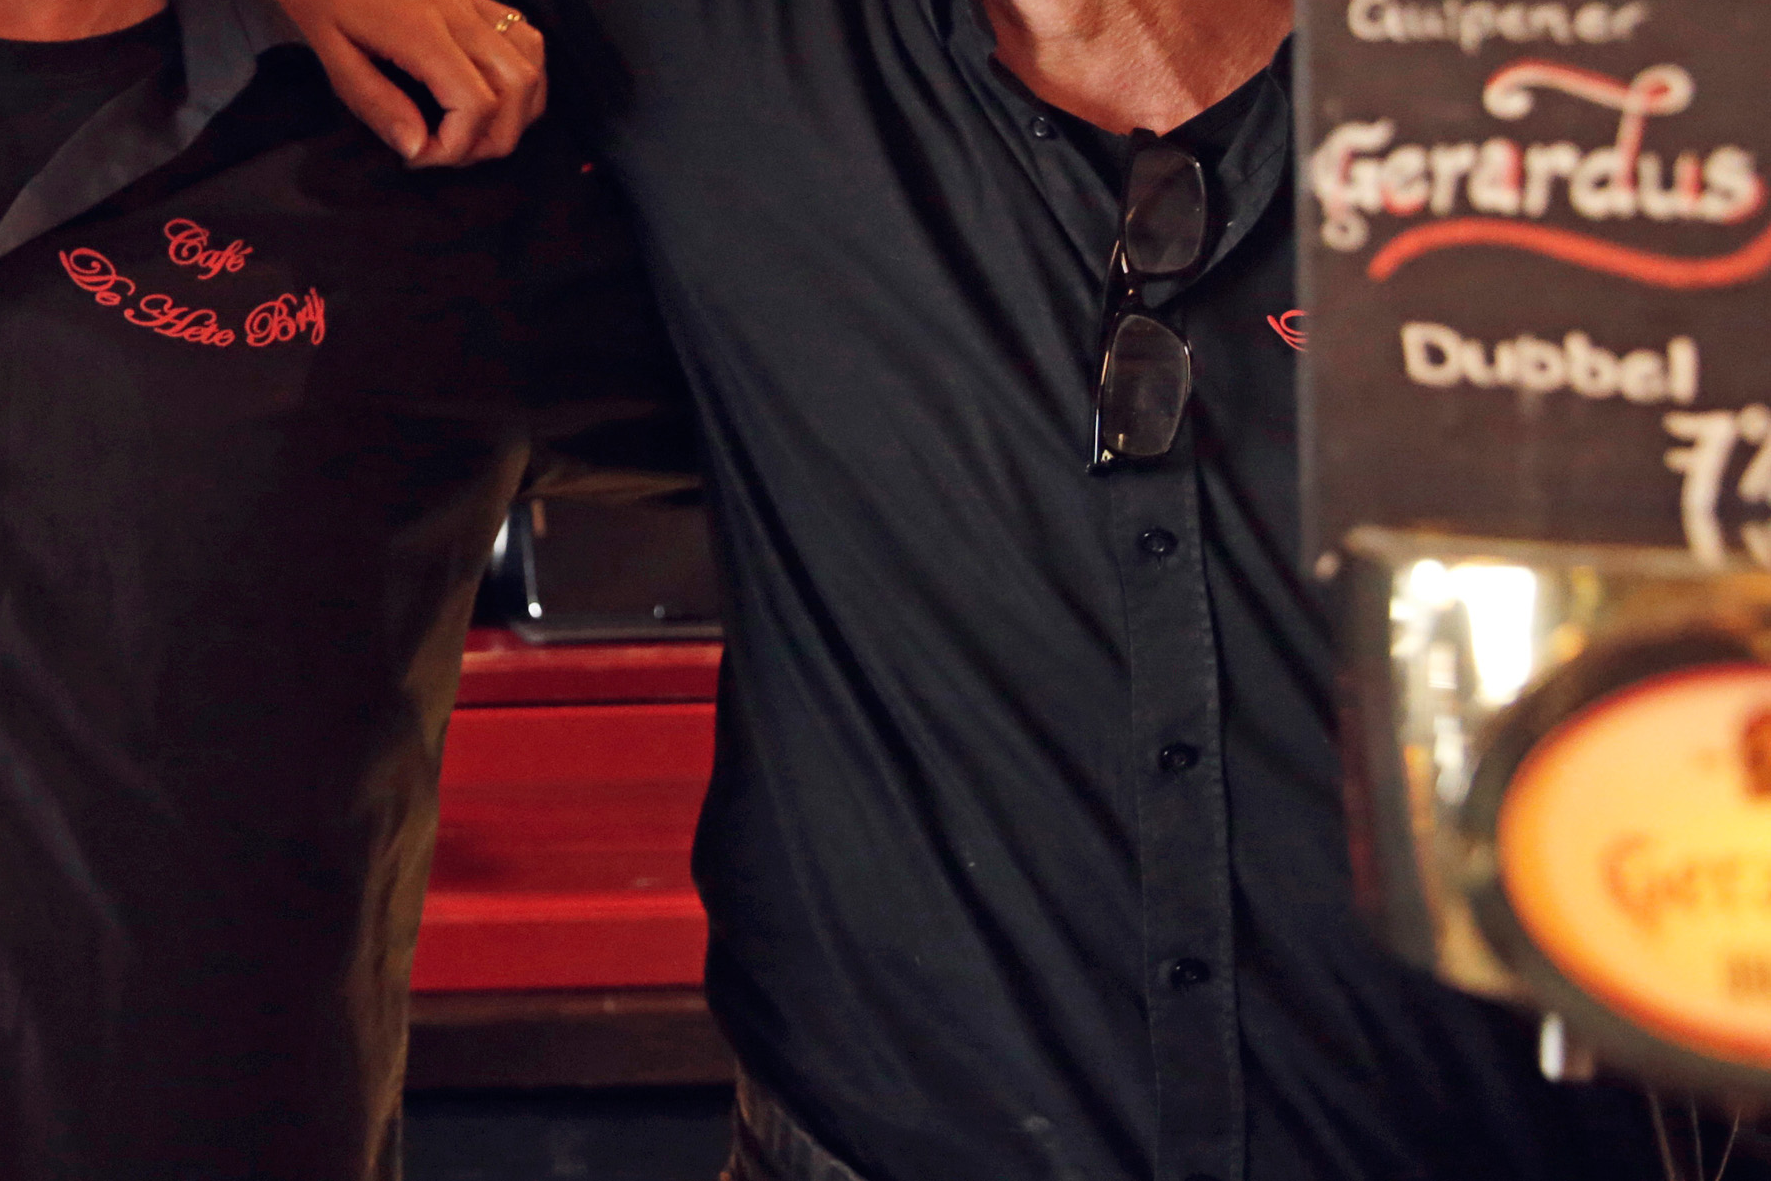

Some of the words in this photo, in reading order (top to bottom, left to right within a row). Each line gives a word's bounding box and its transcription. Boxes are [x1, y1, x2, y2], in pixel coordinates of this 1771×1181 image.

[1308, 62, 1767, 252] Gerardus
[58, 246, 137, 307] De
[162, 217, 254, 280] Café
[1398, 320, 1701, 405] Dubbel
